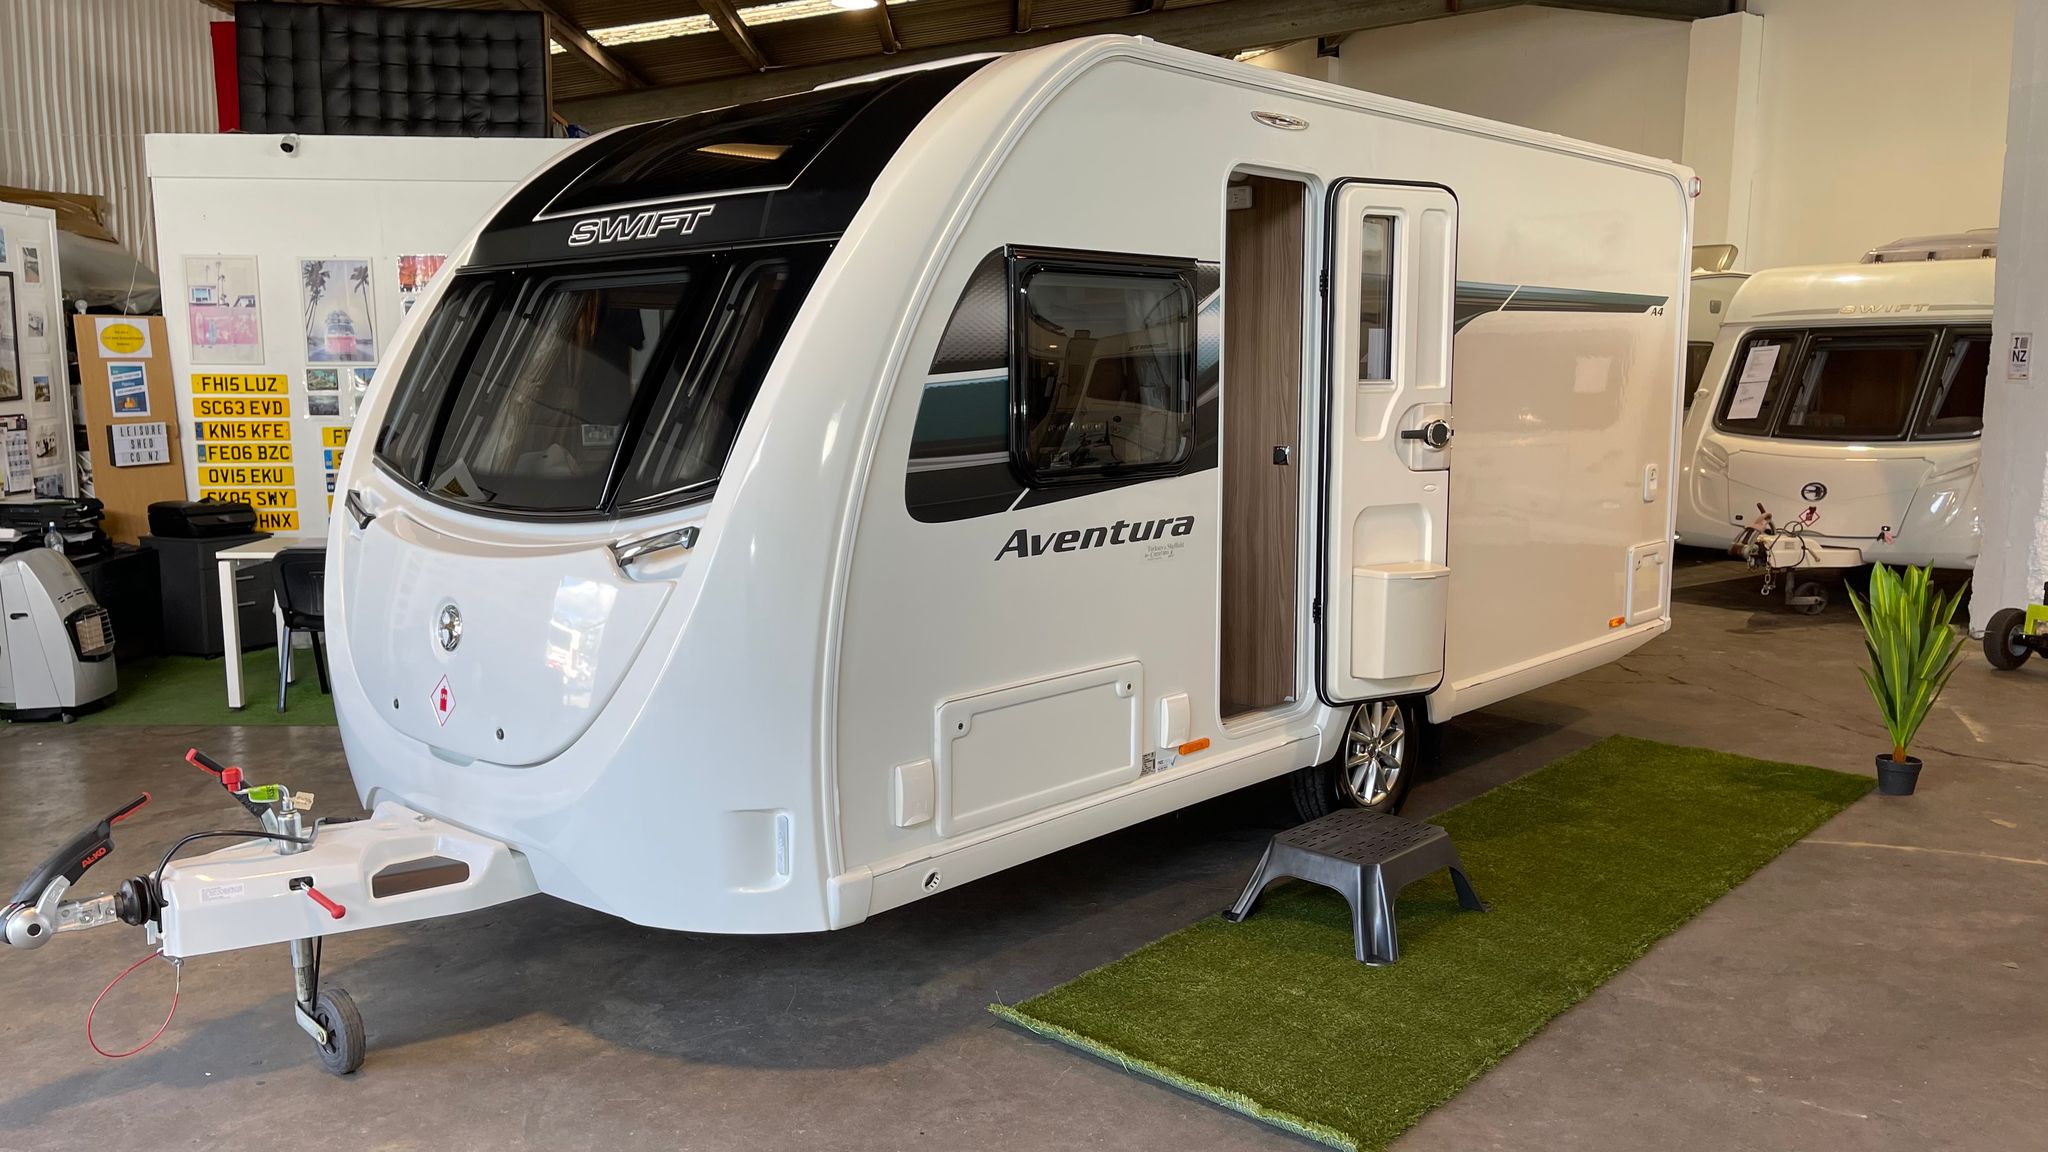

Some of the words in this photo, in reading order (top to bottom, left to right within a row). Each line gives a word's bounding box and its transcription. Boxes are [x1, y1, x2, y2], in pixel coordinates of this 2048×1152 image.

[568, 203, 716, 247] SWIFT
[1650, 307, 1664, 317] A4
[1839, 303, 1930, 314] SWIFT
[2012, 350, 2027, 362] NZ
[244, 377, 278, 392] LUZ
[200, 400, 245, 415] SC63
[249, 400, 283, 415] EVD
[120, 424, 162, 437] LEISURE
[251, 423, 285, 438] KFE
[130, 438, 154, 450] SHED
[208, 445, 252, 461] FE06
[257, 445, 290, 461] BZC
[250, 468, 283, 484] EKU
[256, 491, 288, 506] SWY
[259, 513, 292, 529] HNX
[994, 515, 1195, 562] Aventura
